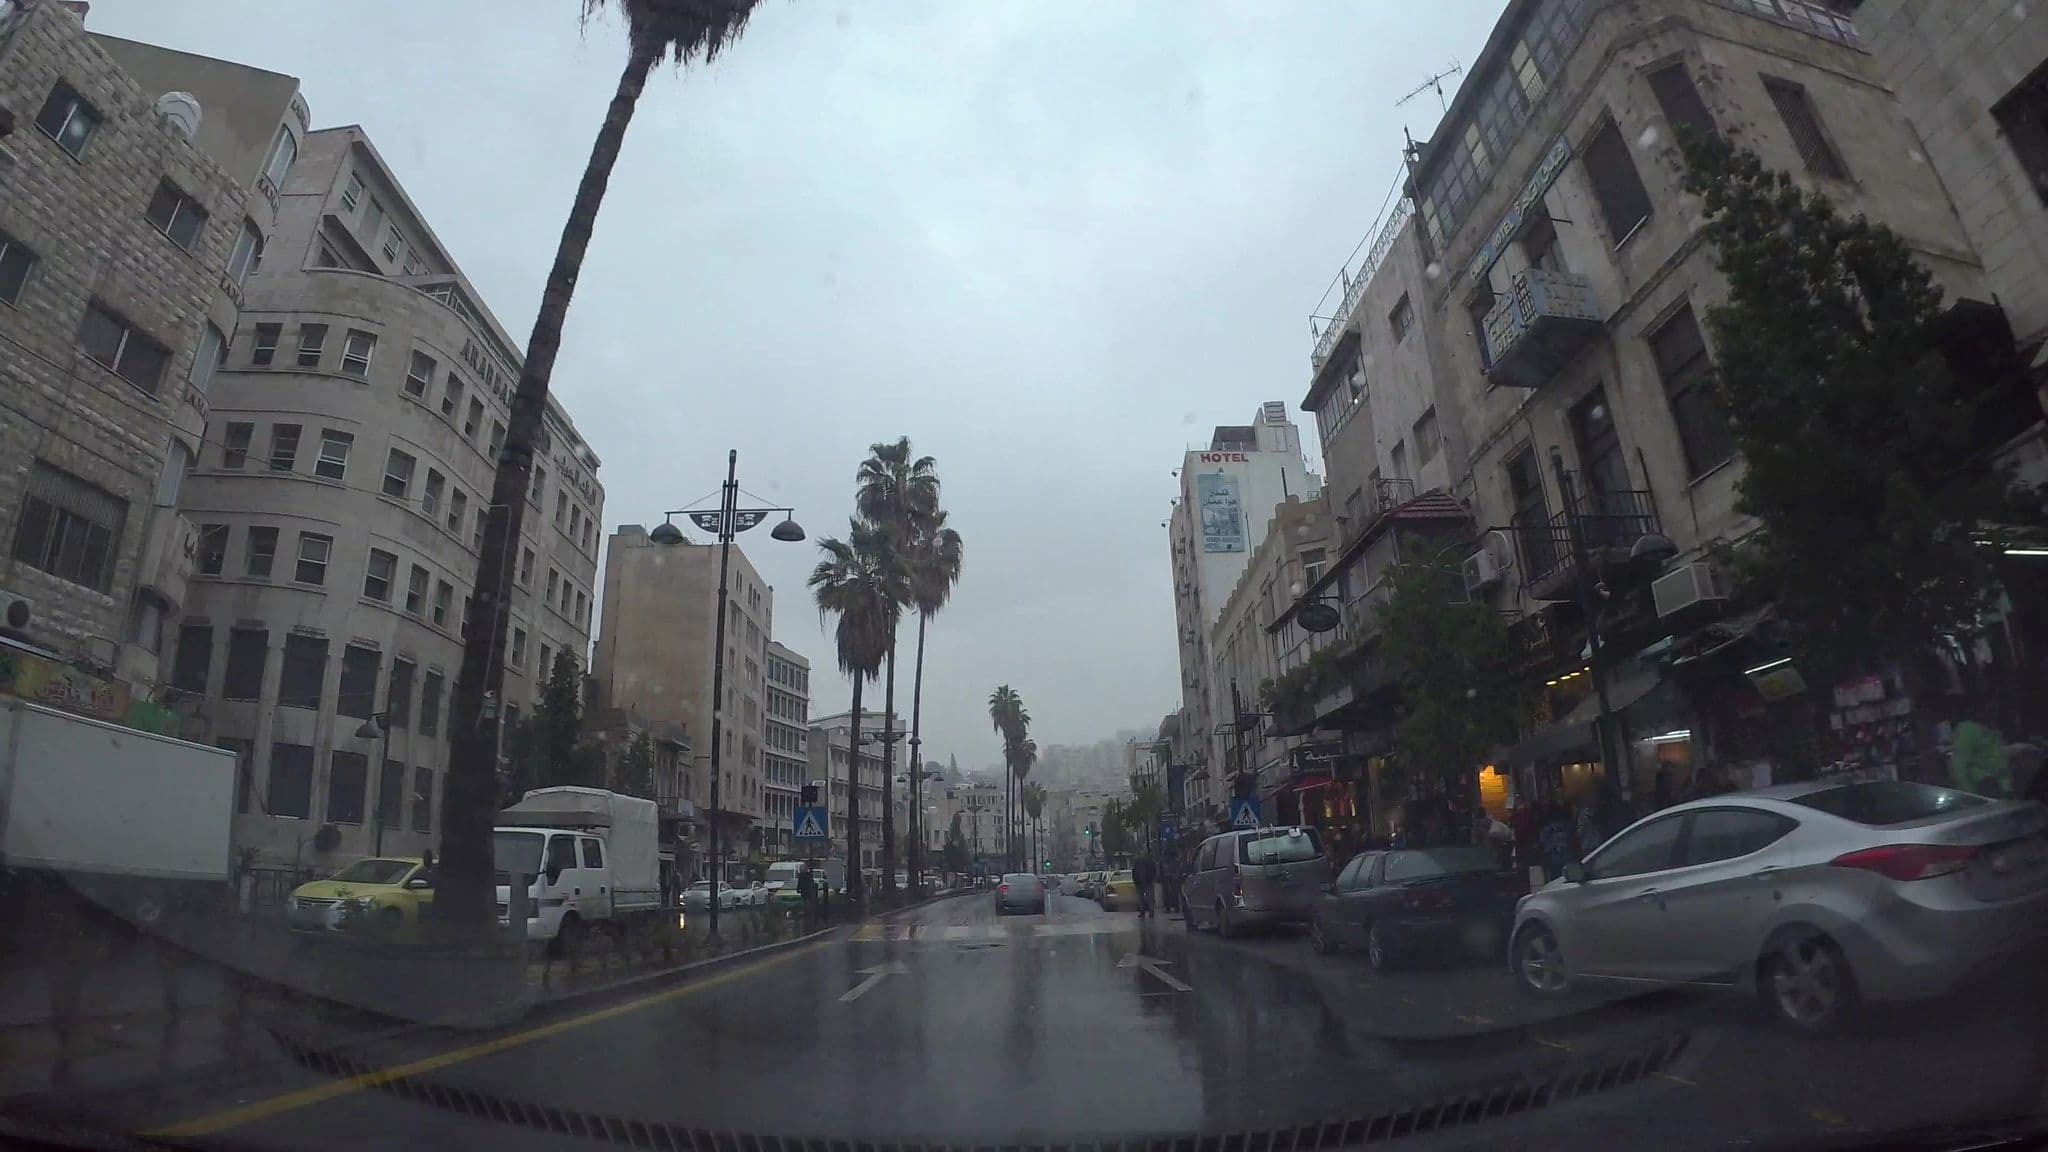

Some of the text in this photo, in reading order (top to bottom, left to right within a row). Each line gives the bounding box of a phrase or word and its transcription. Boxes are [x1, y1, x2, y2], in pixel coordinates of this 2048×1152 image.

[1493, 221, 1516, 250] HOTEL
[460, 338, 517, 408] ARAB BAN
[1200, 452, 1249, 463] HOTEL
